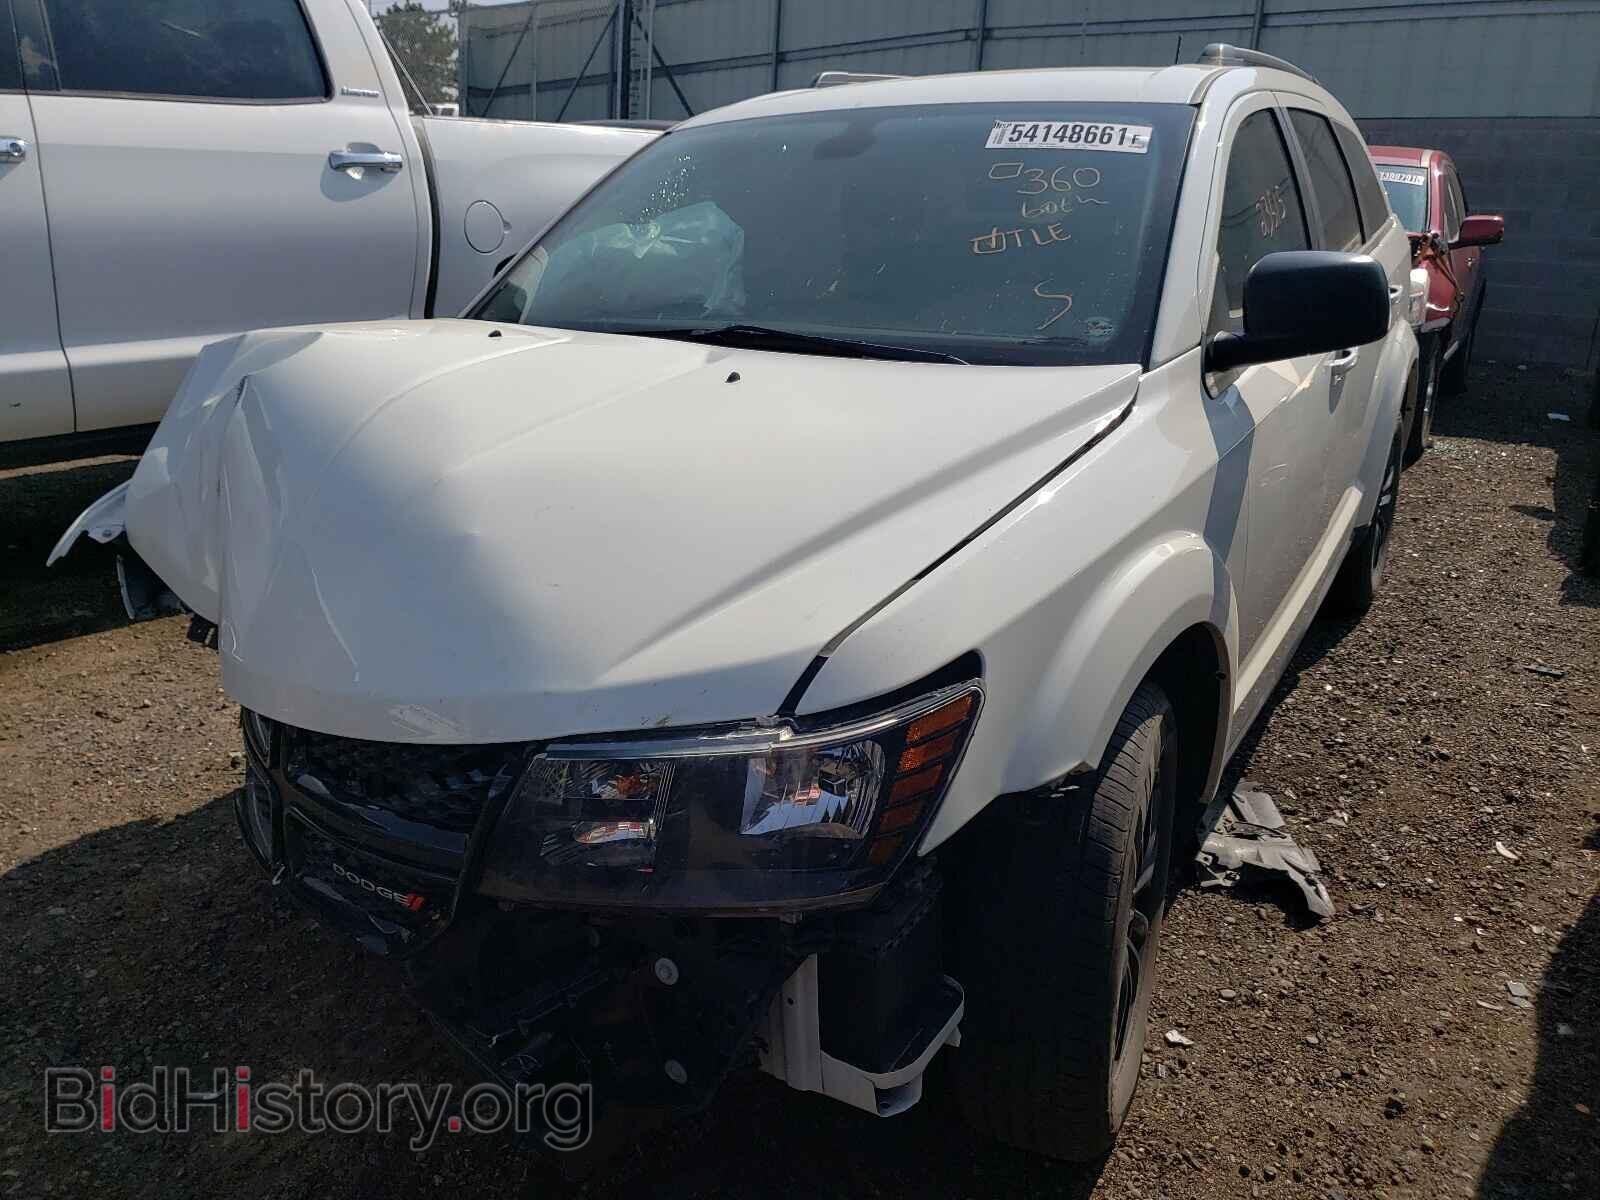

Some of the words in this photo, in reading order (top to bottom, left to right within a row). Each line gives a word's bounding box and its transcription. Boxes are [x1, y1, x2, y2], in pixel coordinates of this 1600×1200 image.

[1008, 123, 1128, 146] 54148661
[1016, 166, 1101, 195] 360
[332, 863, 412, 907] DODGE
